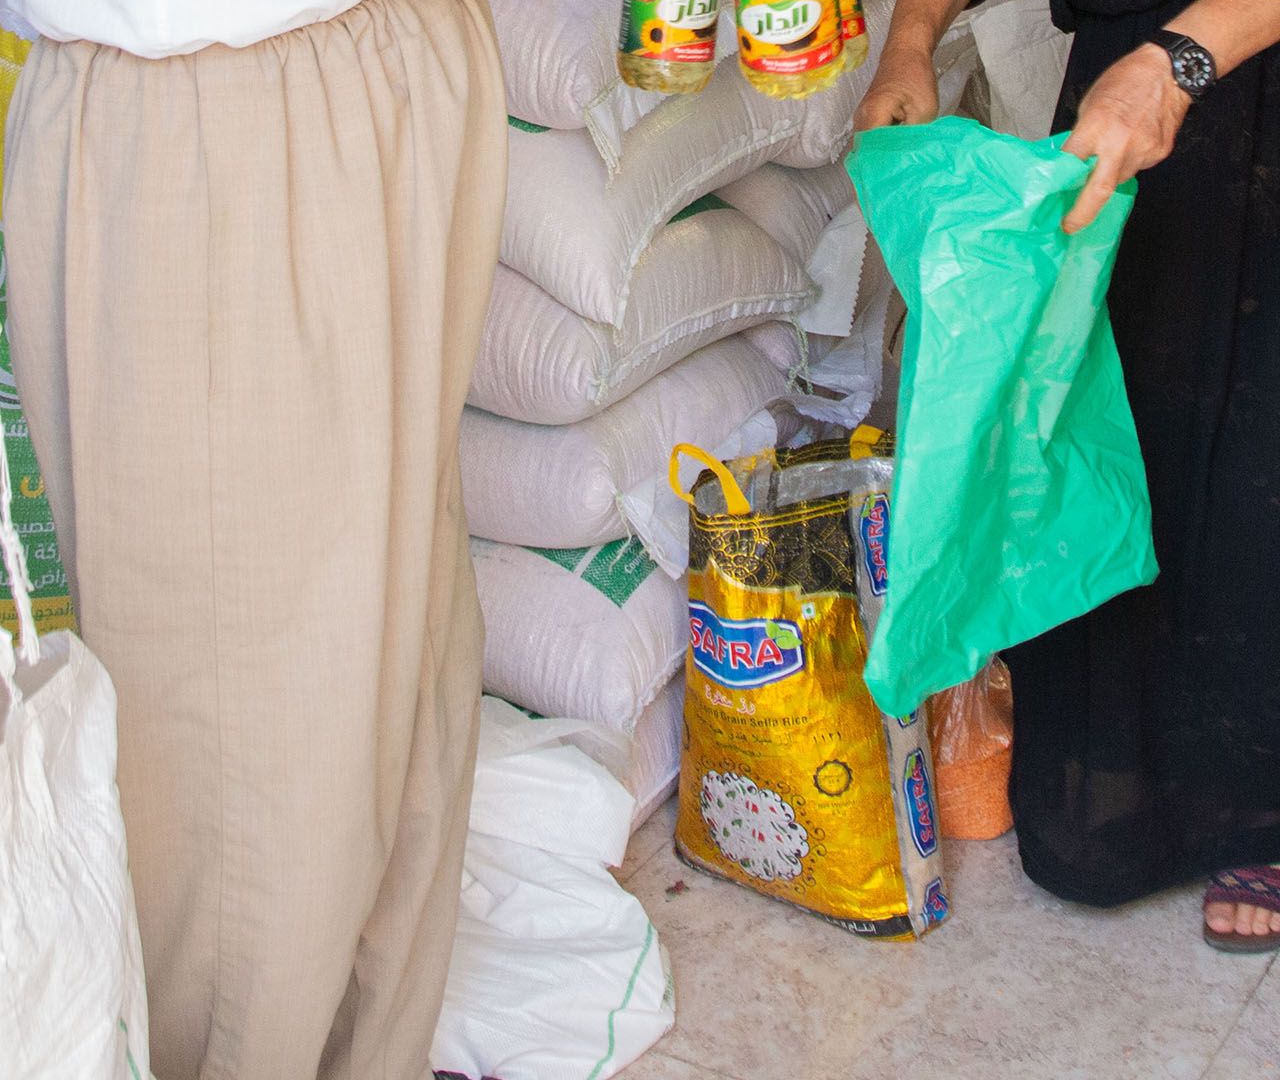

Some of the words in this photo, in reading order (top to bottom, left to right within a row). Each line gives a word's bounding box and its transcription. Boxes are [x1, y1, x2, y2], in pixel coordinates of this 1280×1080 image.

[752, 3, 810, 36] الدار
[868, 504, 890, 584] SAFRA
[688, 616, 784, 671] SAFRA
[720, 709, 747, 726] Grain
[782, 714, 809, 727] Rice
